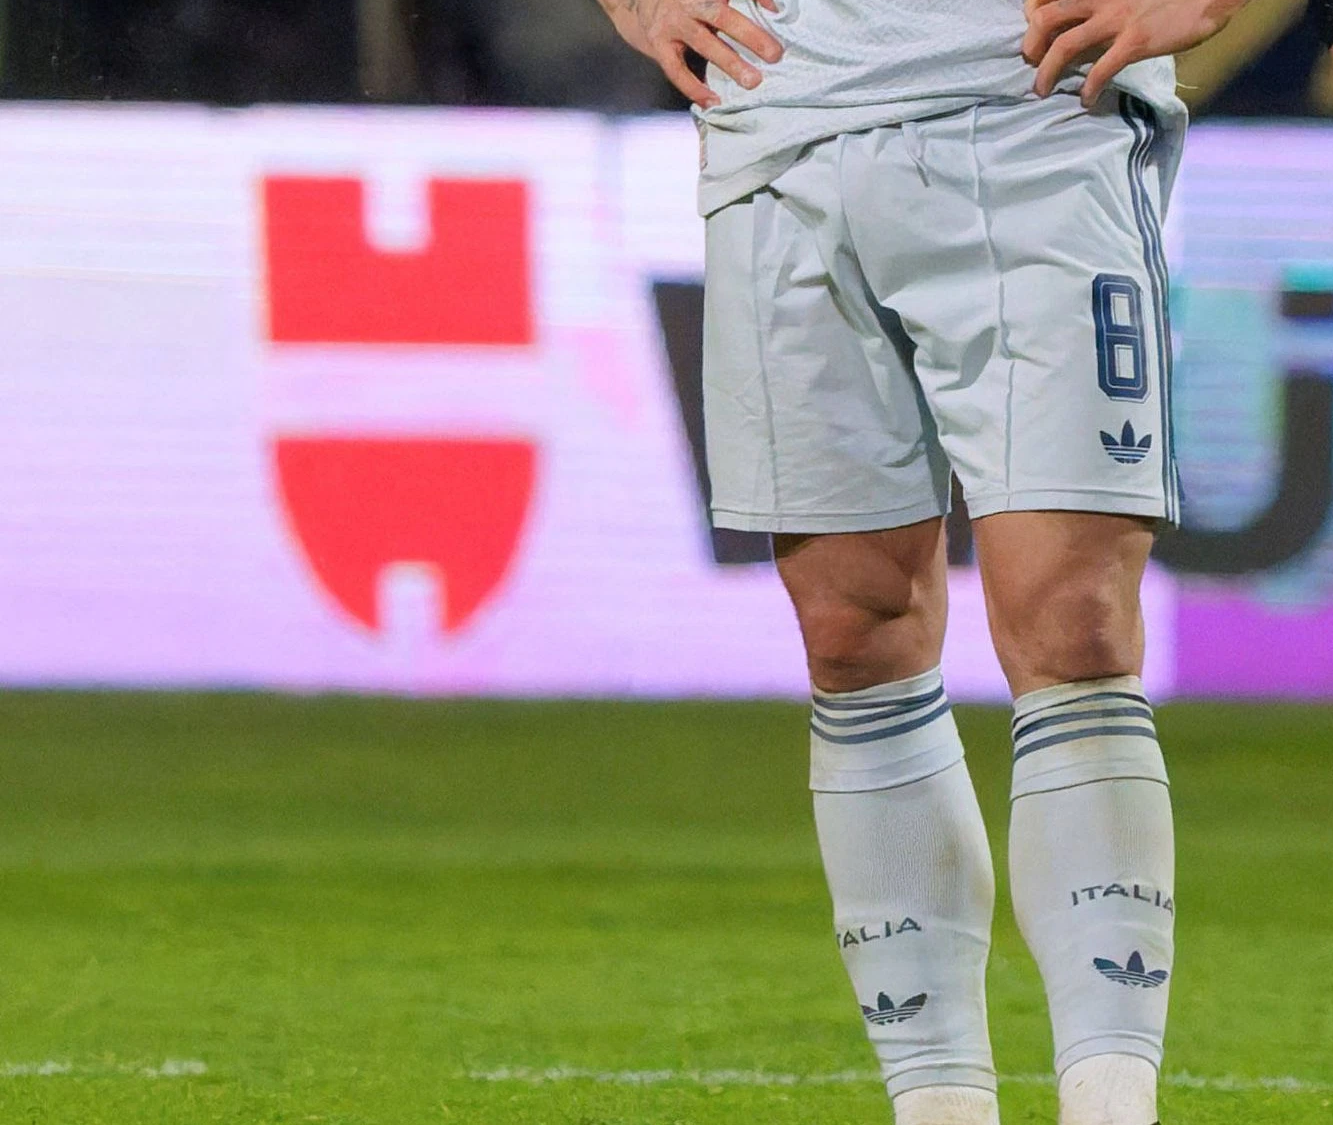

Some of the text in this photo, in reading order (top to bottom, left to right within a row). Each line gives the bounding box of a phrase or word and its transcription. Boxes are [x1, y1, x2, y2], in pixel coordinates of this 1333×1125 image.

[1092, 273, 1151, 404] 8
[1072, 883, 1174, 917] ITALIA
[836, 917, 922, 949] ALIA
